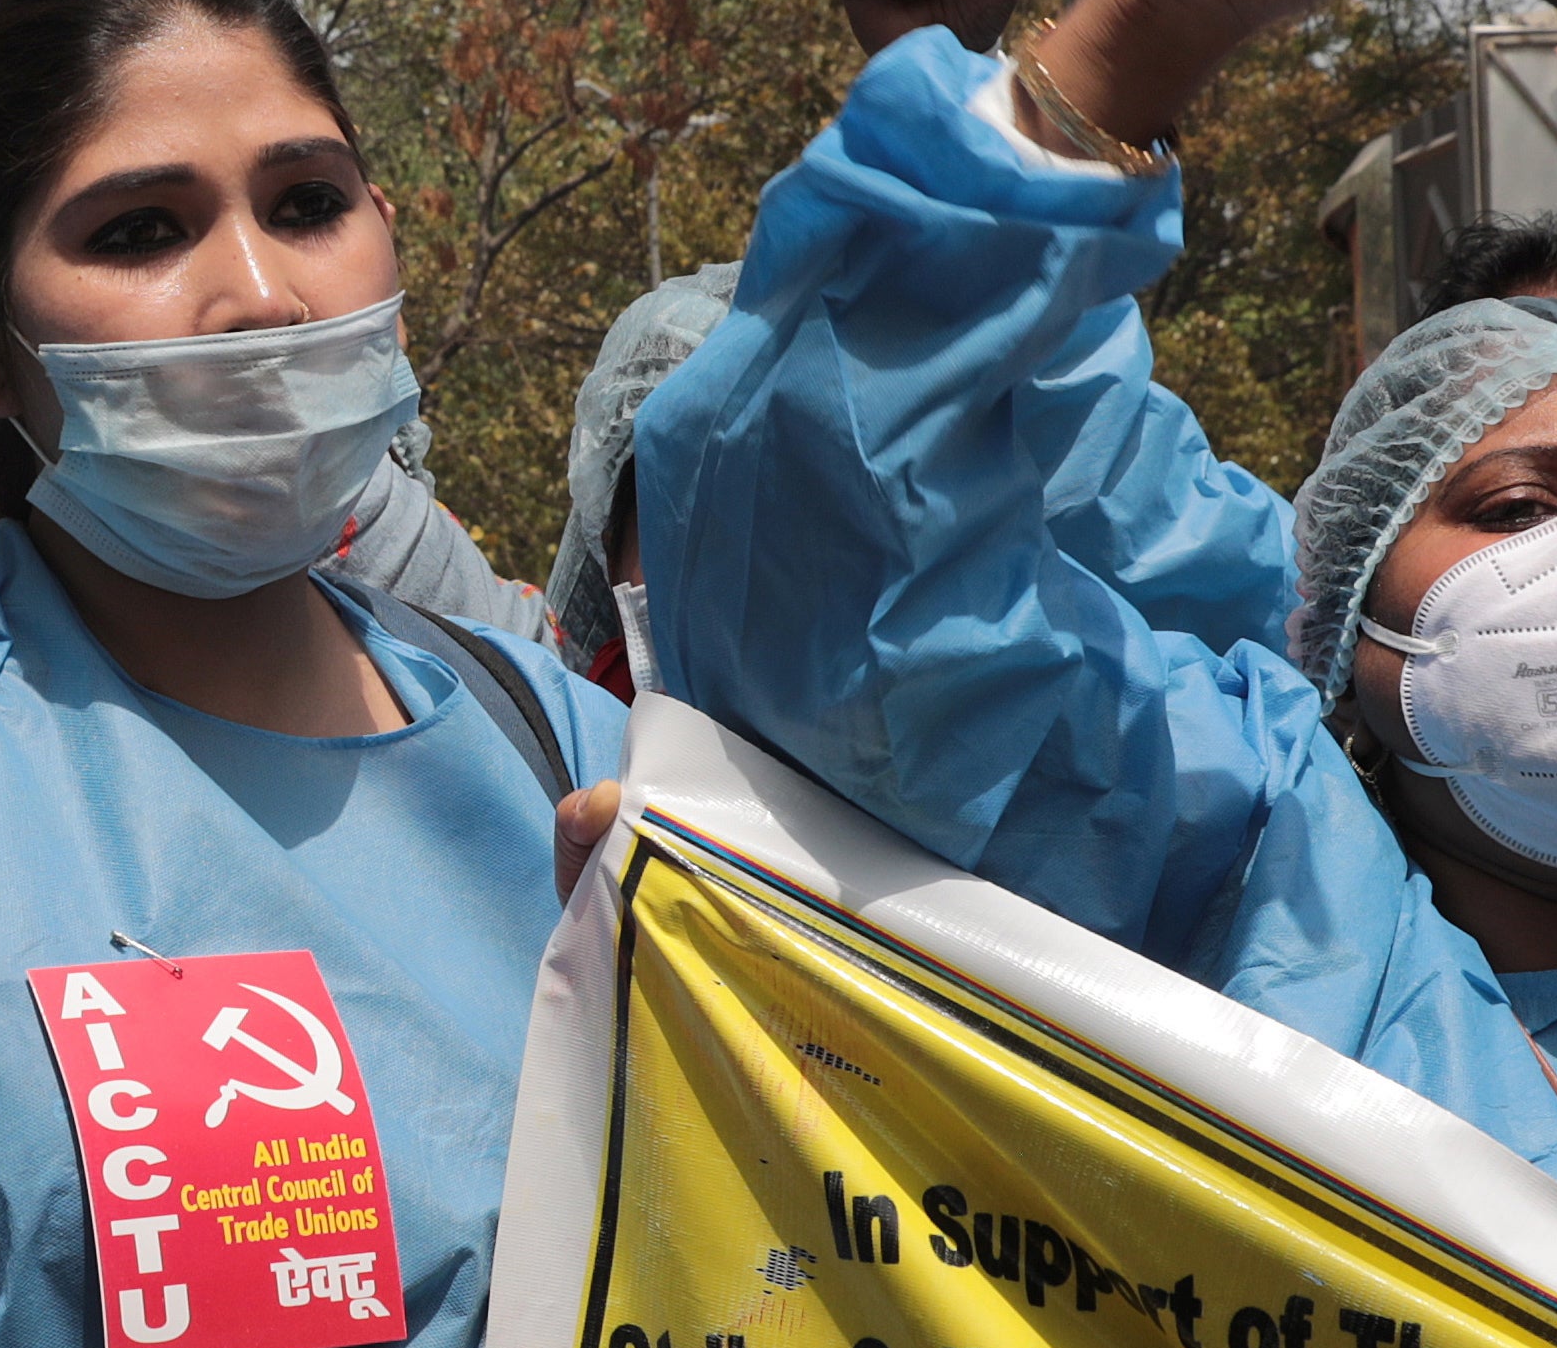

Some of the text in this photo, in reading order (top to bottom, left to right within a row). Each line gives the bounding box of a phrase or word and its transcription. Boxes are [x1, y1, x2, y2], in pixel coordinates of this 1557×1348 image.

[253, 1133, 367, 1168] All India
[180, 1166, 374, 1213] Central Council of
[217, 1205, 379, 1245] Trade Unions
[822, 1170, 900, 1265] In
